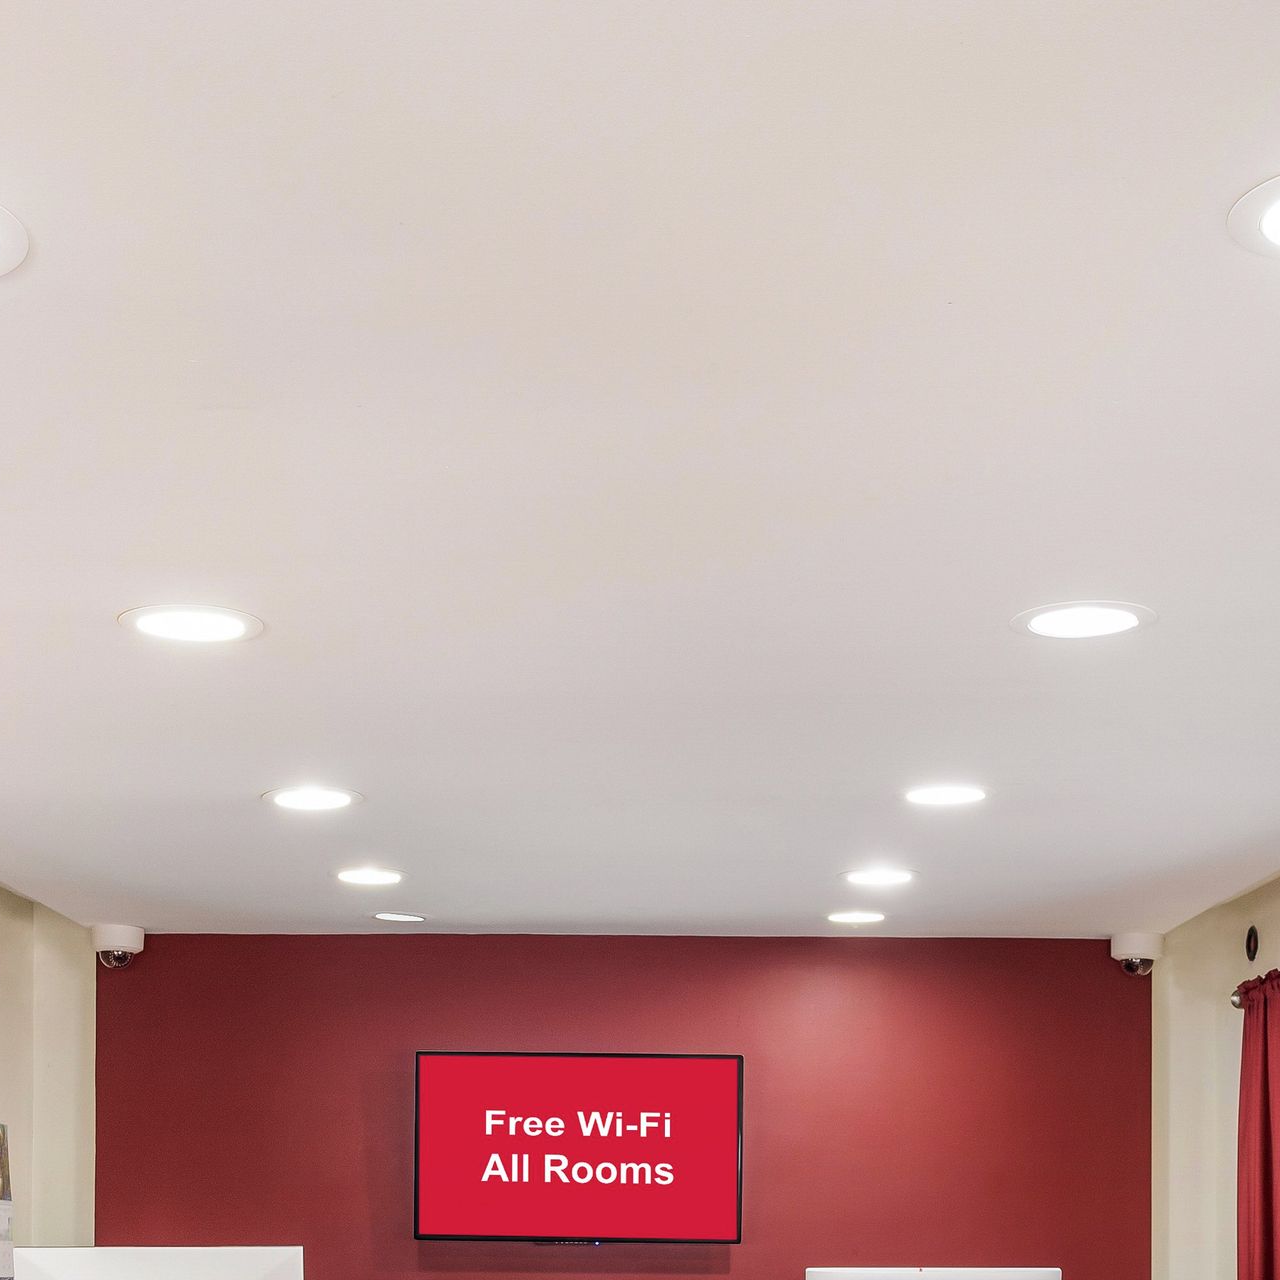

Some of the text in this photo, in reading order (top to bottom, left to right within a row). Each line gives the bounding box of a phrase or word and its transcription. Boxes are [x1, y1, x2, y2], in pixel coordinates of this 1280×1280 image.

[485, 1110, 672, 1138] Free Wi-Fi
[481, 1154, 675, 1185] All Rooms
